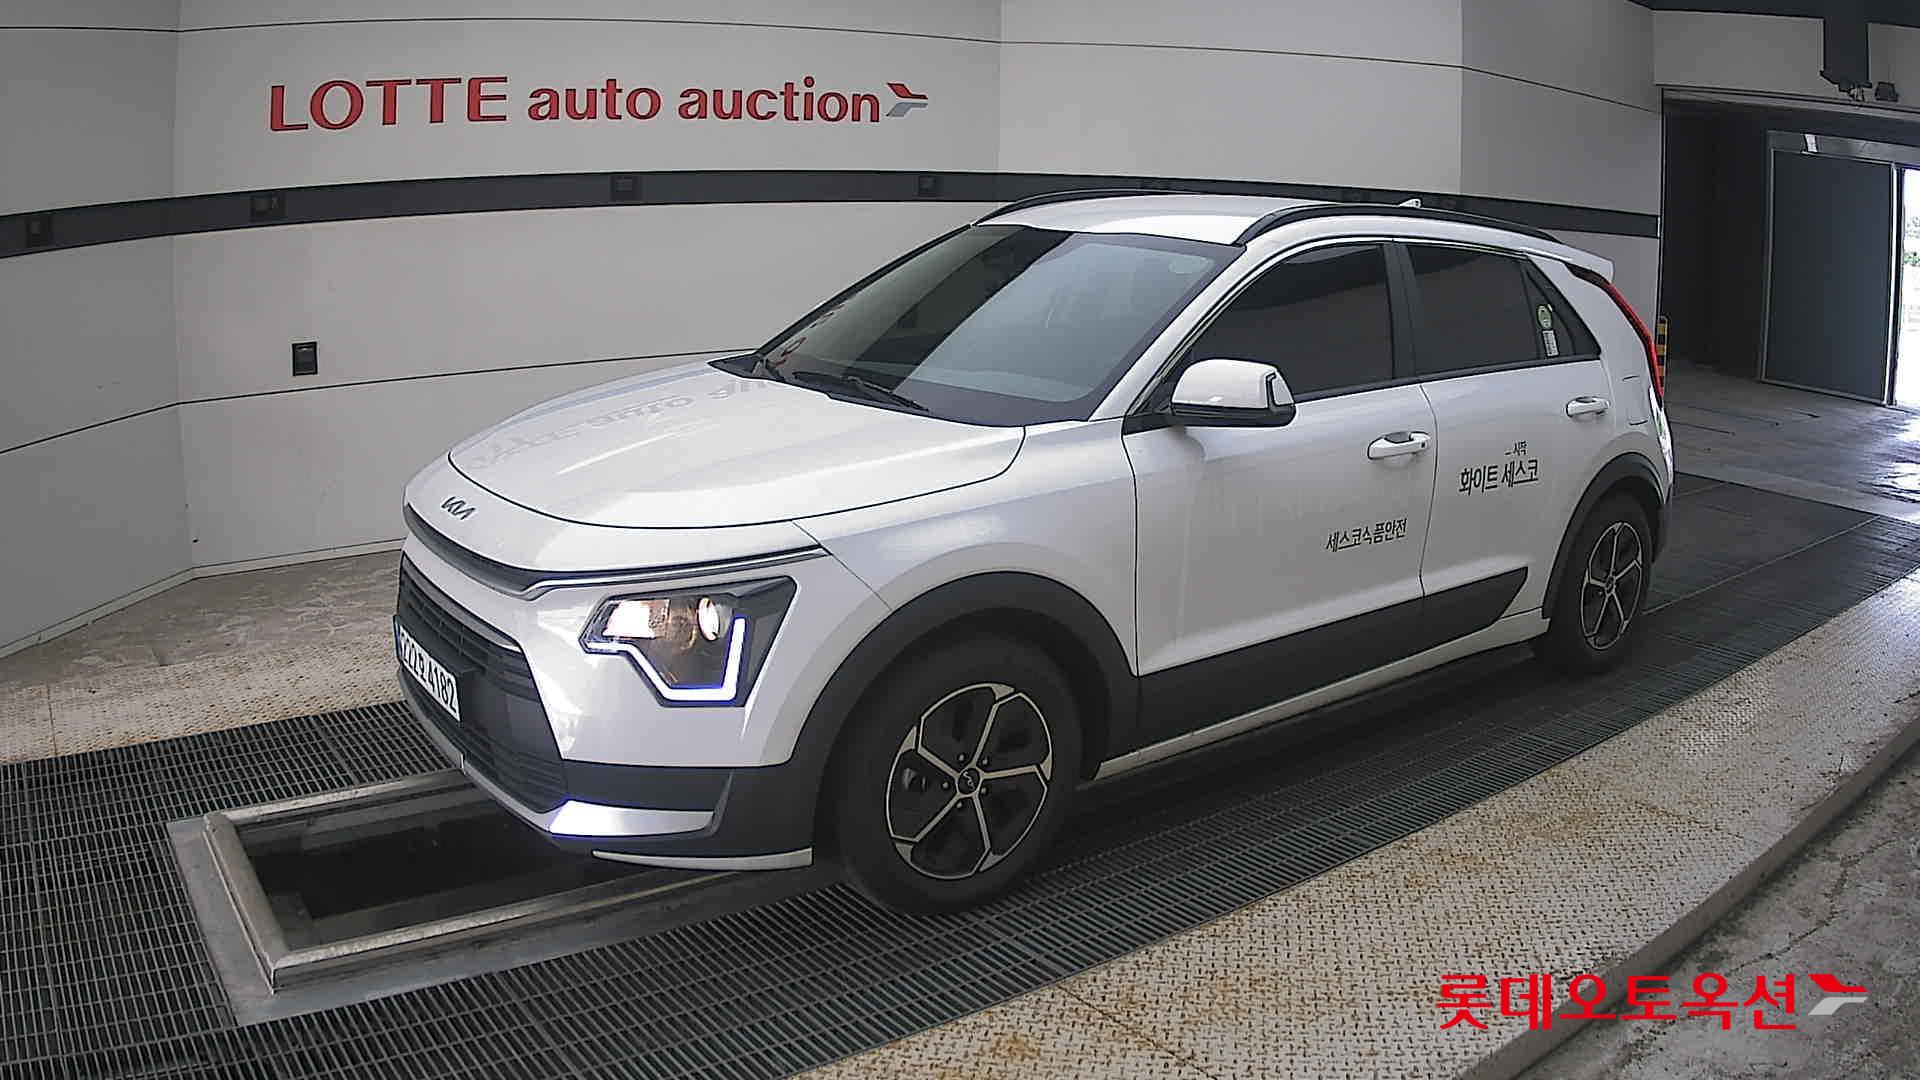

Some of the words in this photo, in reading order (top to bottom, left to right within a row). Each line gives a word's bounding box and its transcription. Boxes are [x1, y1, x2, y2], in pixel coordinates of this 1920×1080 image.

[269, 76, 508, 132] LOTTE
[527, 78, 662, 121] auto
[677, 76, 881, 123] auction
[1458, 465, 1498, 496] 화이트
[1501, 459, 1539, 488] 세스코
